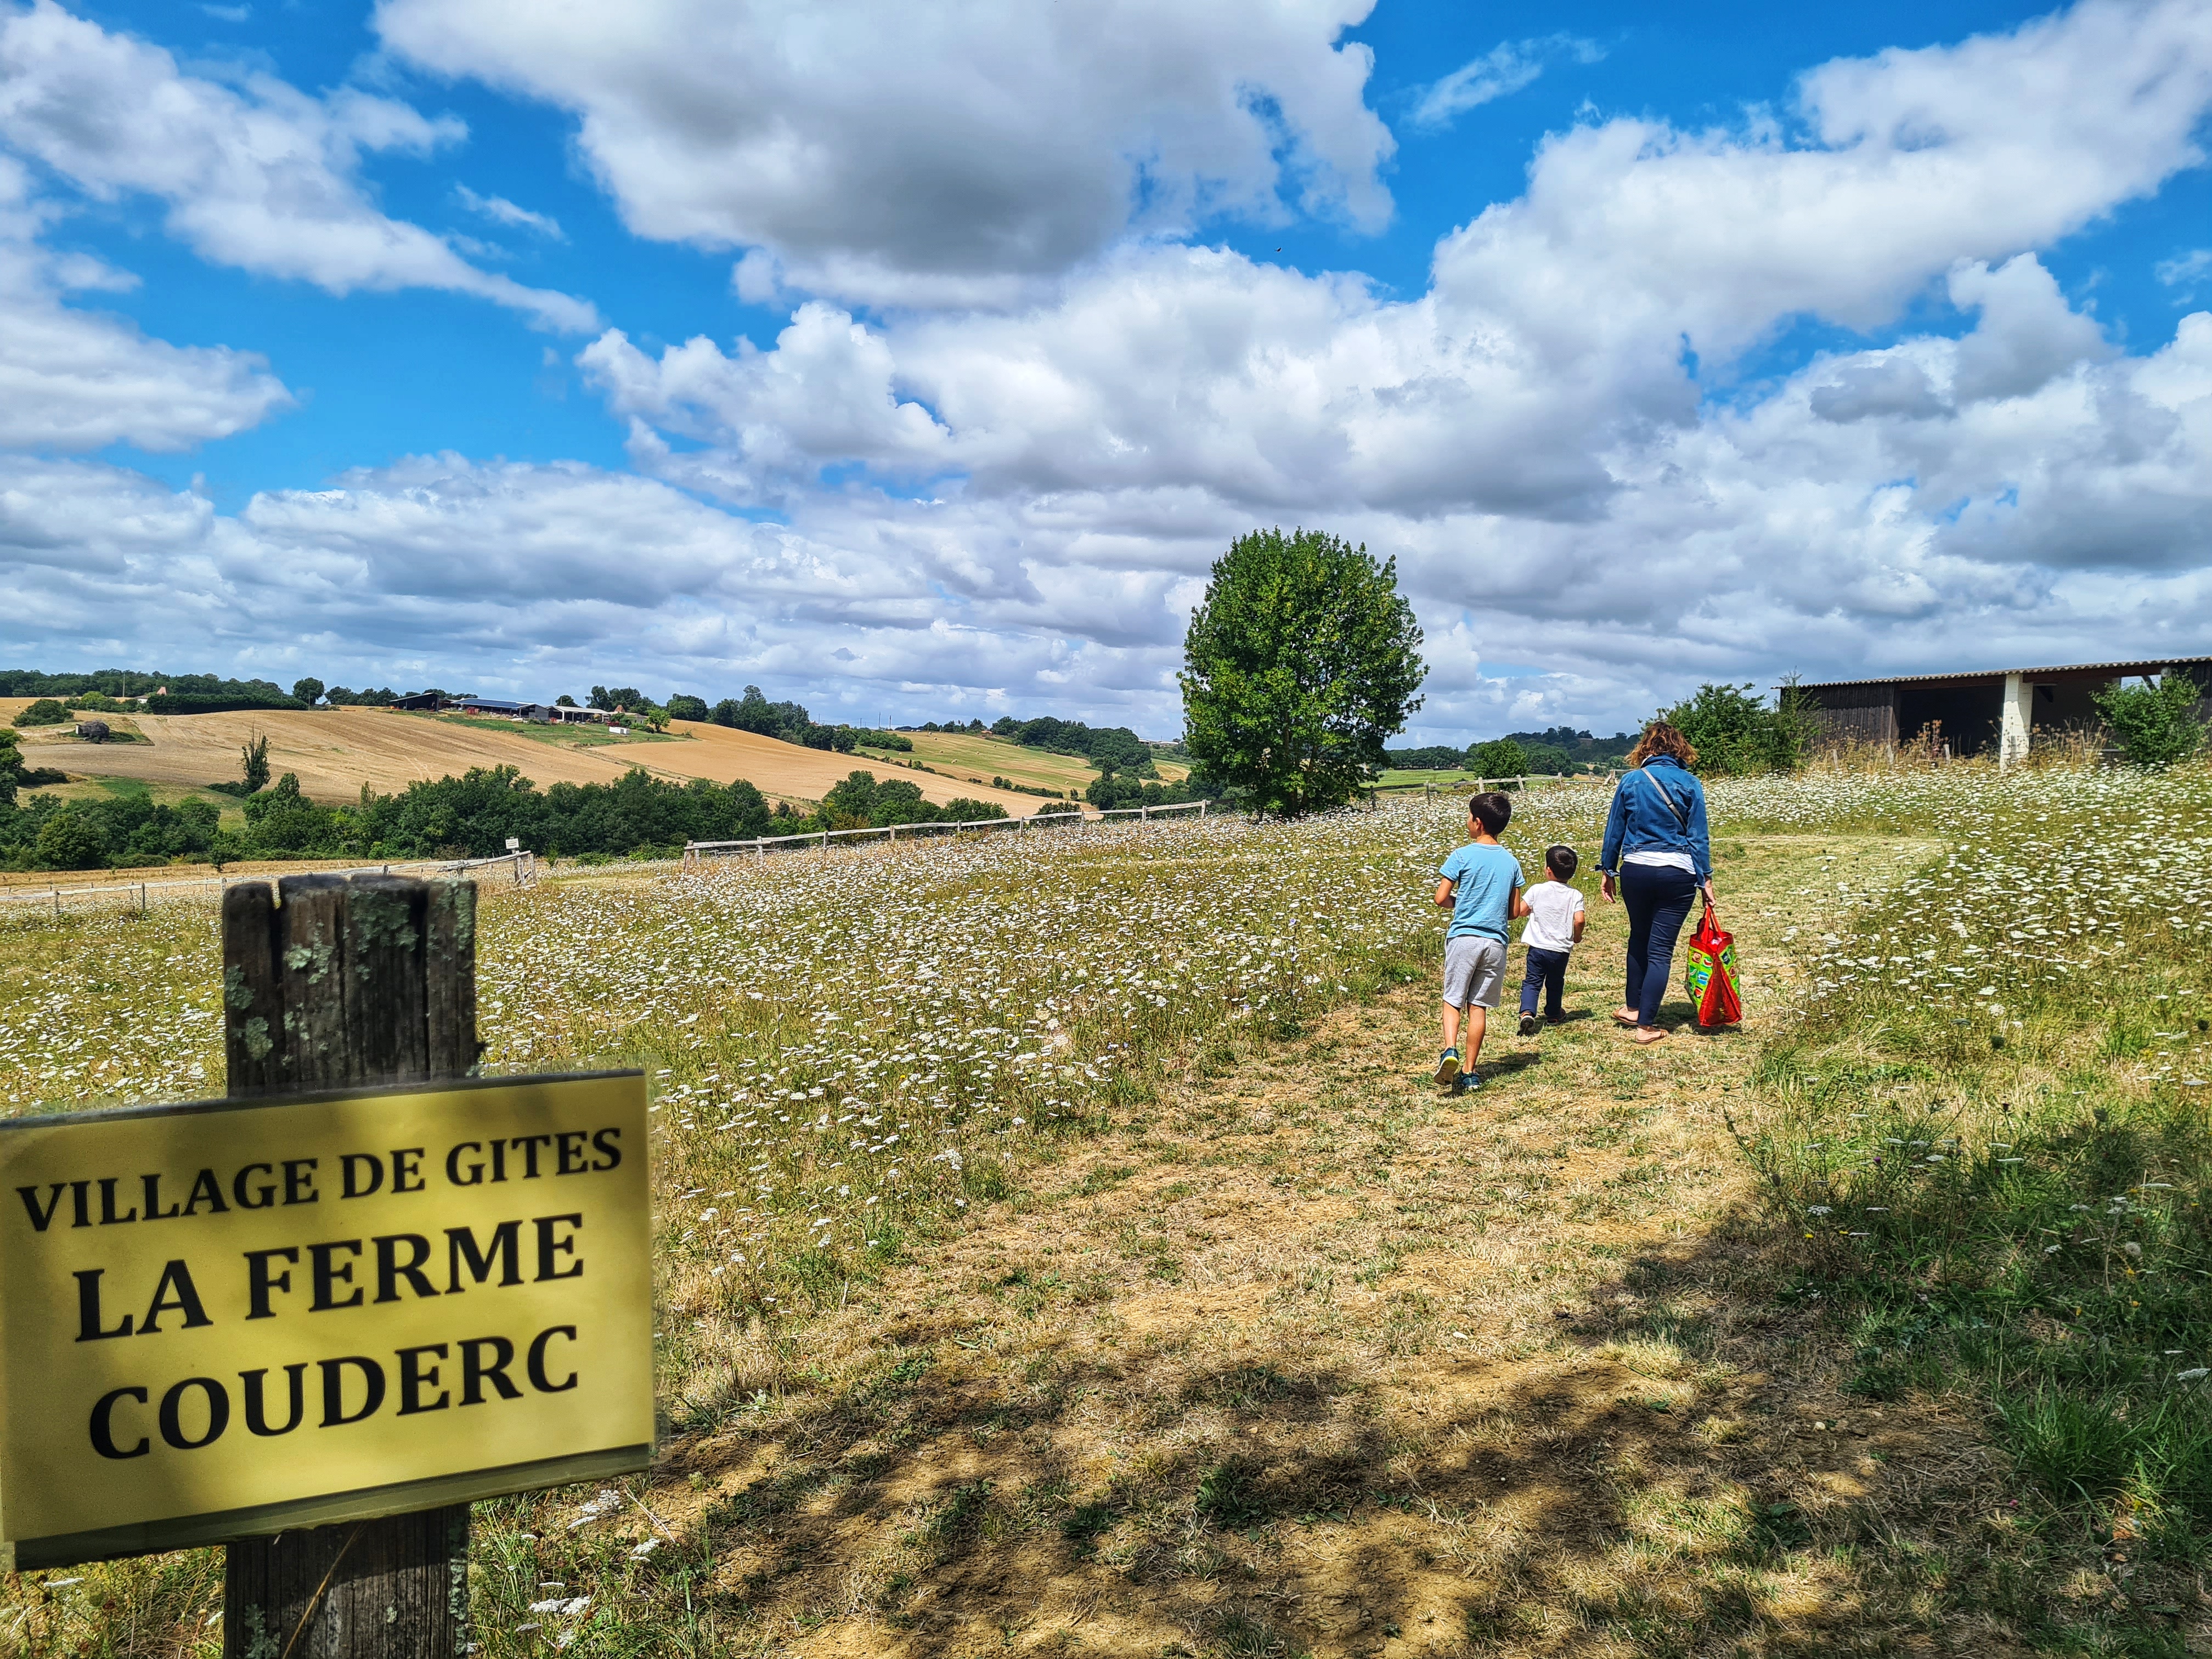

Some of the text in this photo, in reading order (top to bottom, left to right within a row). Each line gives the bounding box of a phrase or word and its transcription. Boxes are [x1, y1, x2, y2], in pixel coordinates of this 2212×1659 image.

[14, 1127, 622, 1233] VILLAGE DE GITES
[72, 1213, 583, 1343] LA FERME
[88, 1325, 578, 1460] COUDERC
